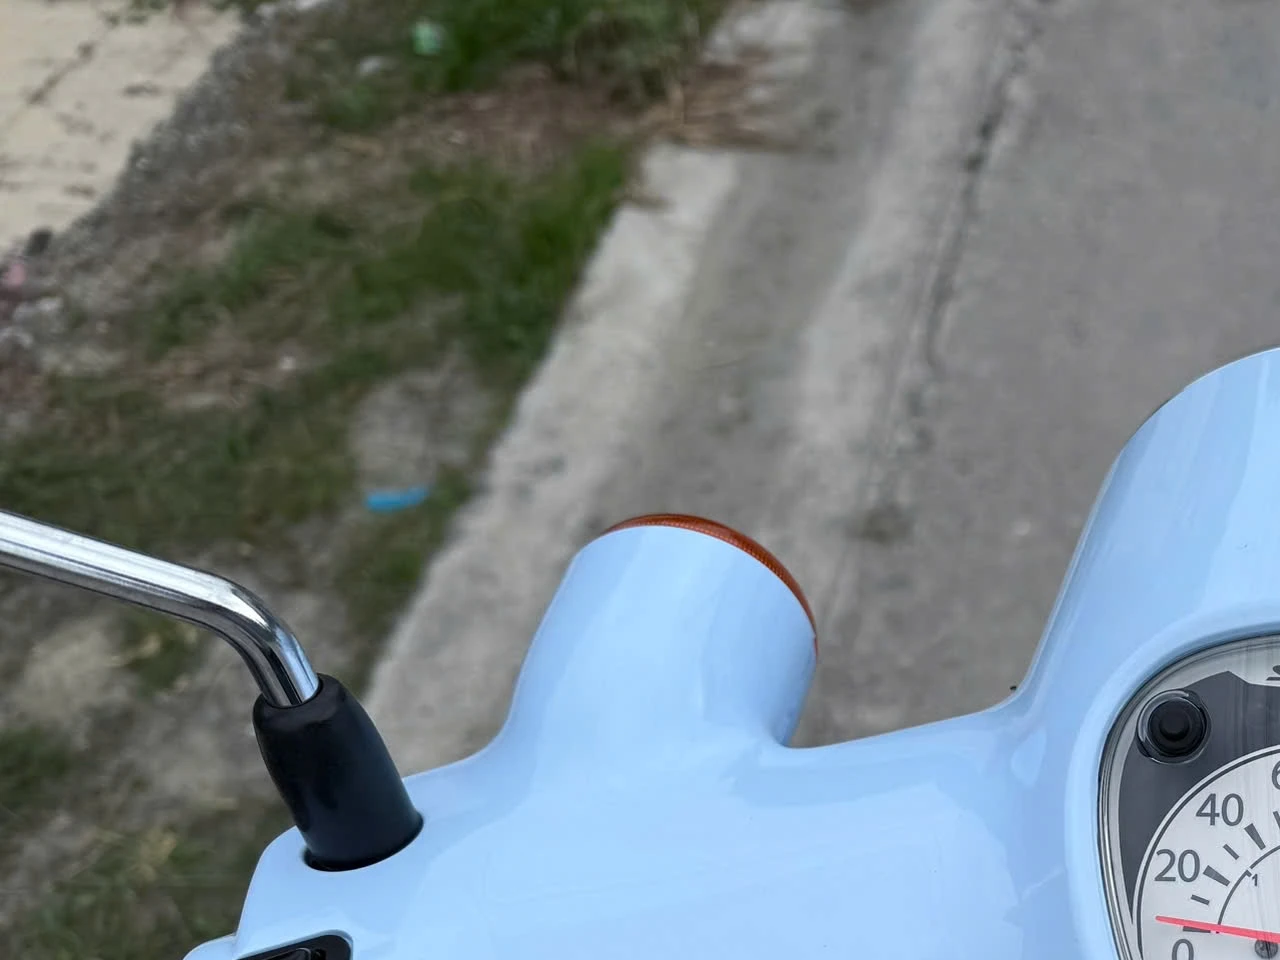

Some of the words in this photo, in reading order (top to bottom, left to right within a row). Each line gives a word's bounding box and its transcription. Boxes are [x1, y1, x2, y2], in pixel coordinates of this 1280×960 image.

[1196, 793, 1244, 826] 40
[1154, 849, 1201, 883] 20
[1251, 873, 1259, 887] 1
